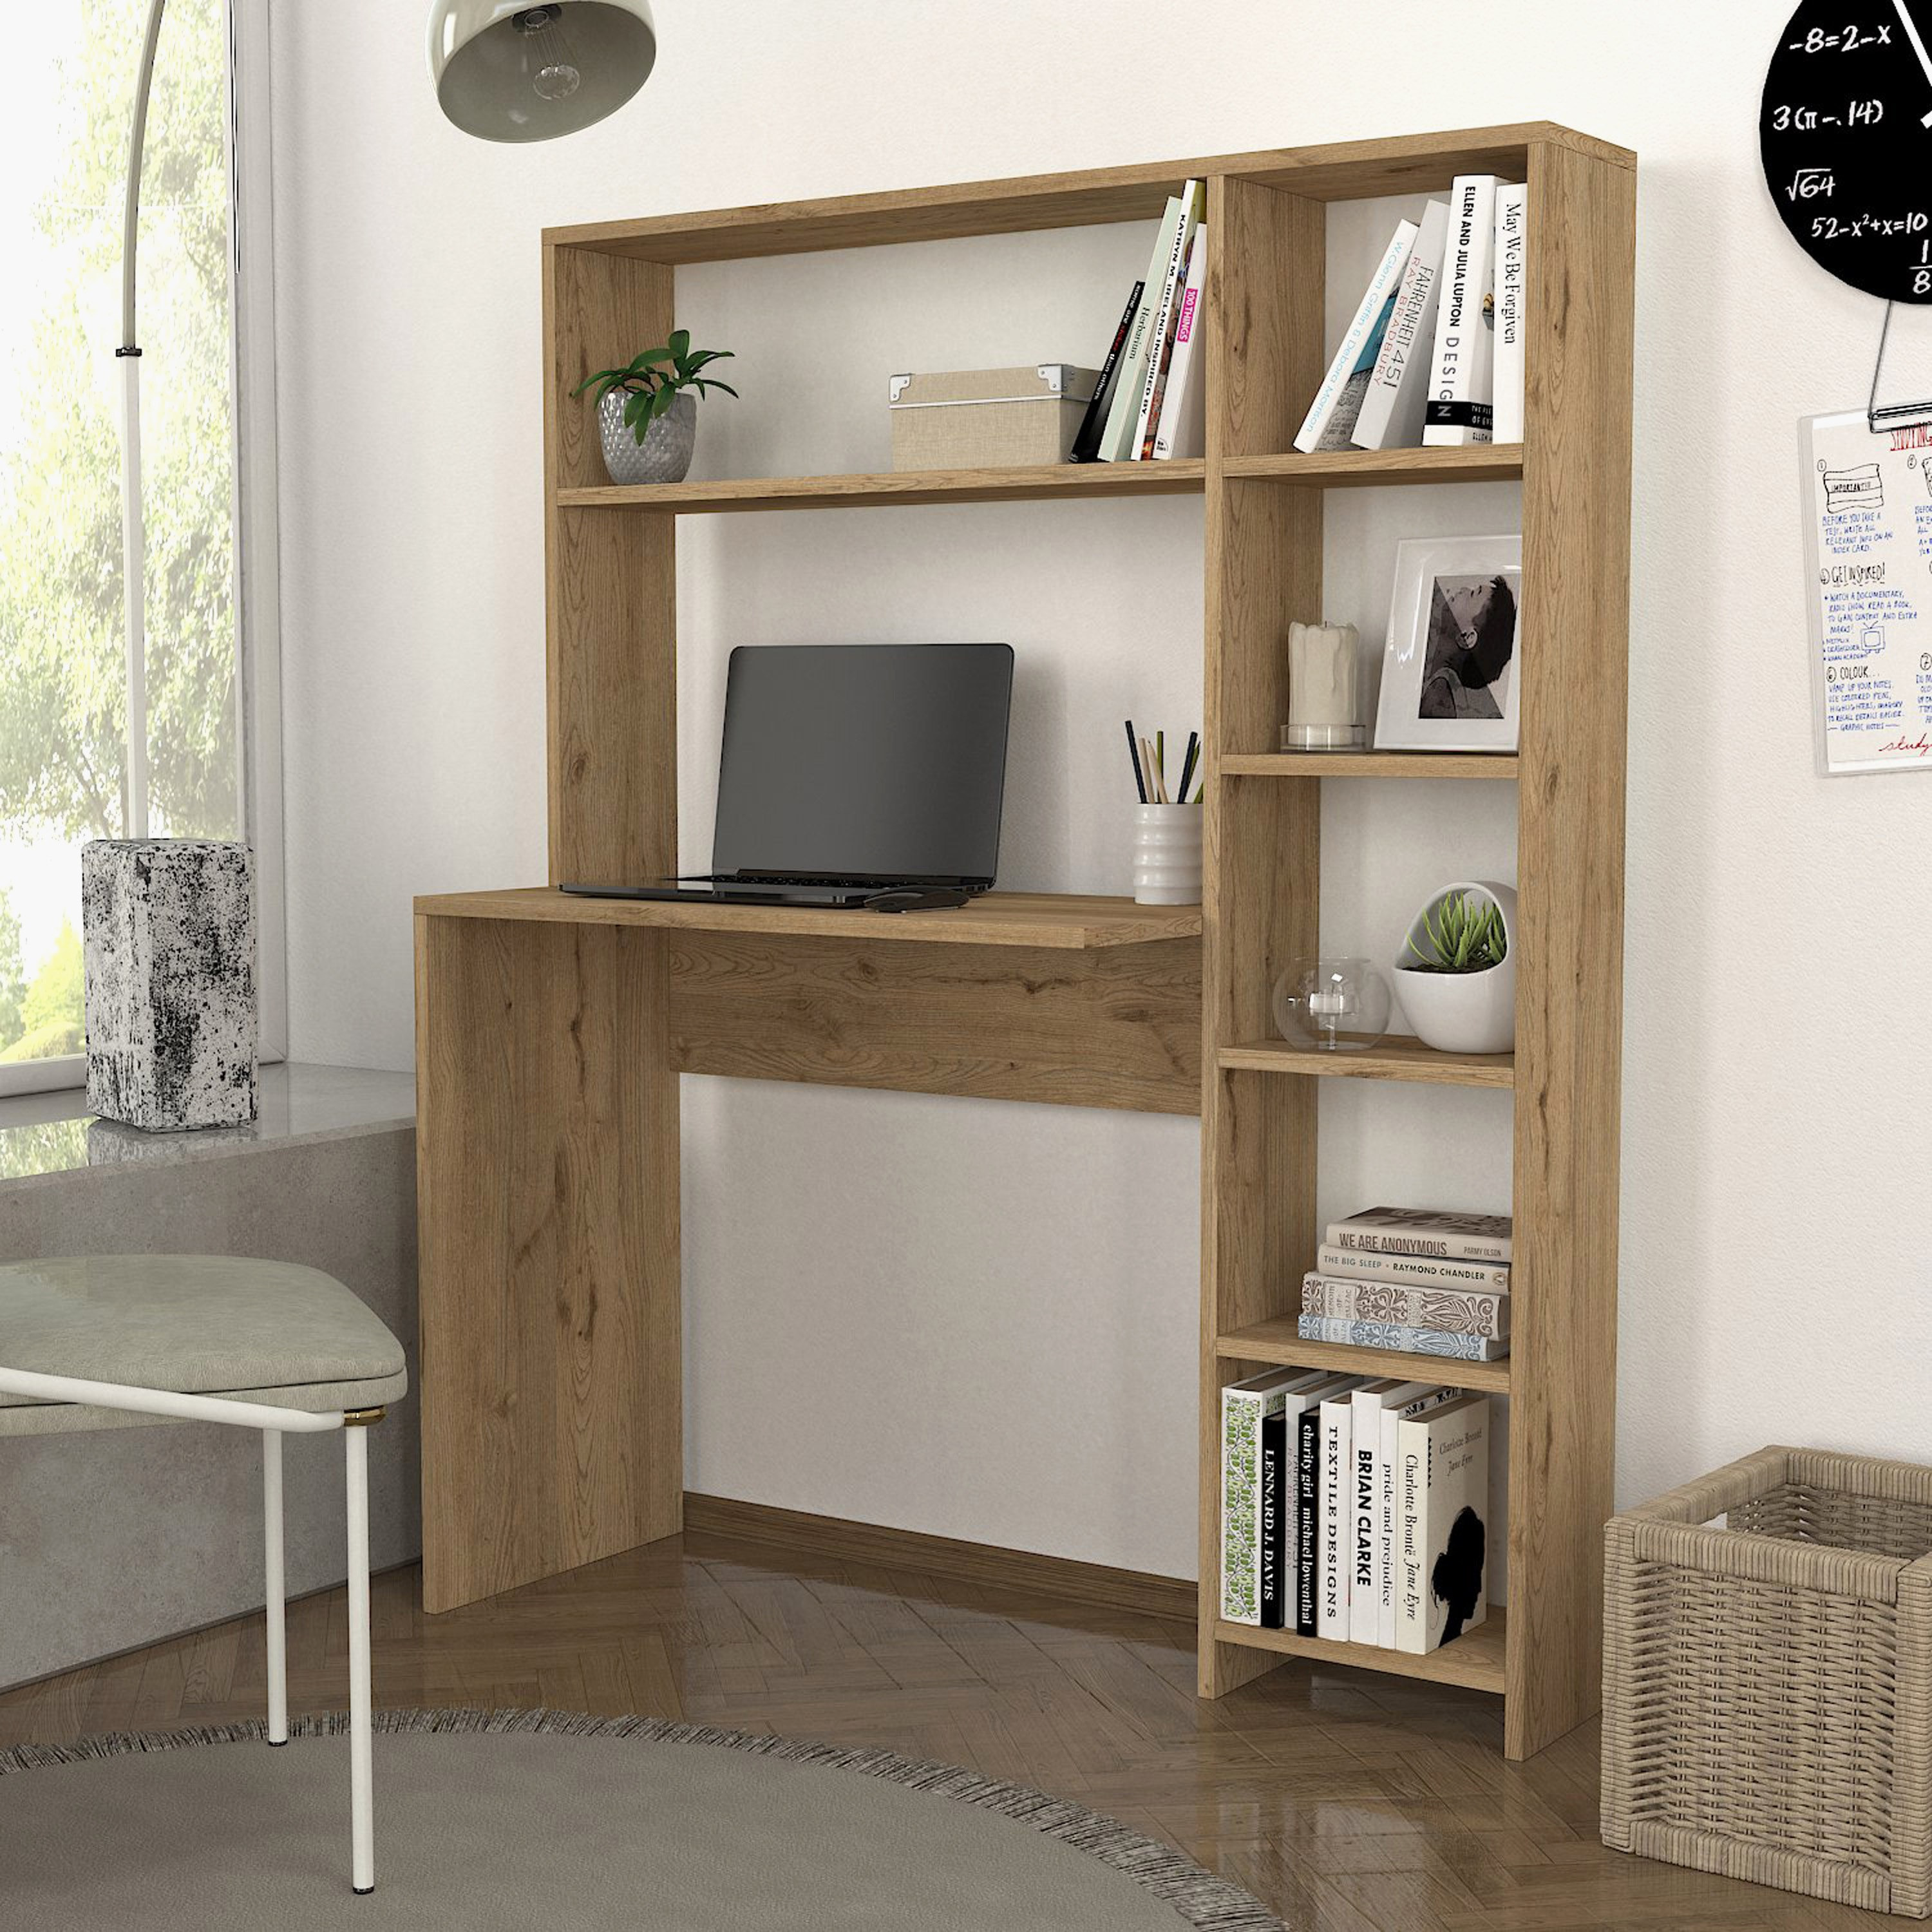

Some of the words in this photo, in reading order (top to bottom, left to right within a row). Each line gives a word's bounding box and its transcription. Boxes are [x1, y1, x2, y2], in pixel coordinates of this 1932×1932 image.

[1462, 185, 1476, 218] ELLEN
[1502, 202, 1522, 232] May
[1458, 220, 1472, 247] AND
[1505, 235, 1522, 260] We
[1406, 257, 1421, 289] RAY
[1454, 249, 1468, 281] JULIA
[1505, 263, 1521, 282] Be
[1157, 284, 1171, 336] IRELAND
[1186, 291, 1196, 305] 100
[1396, 265, 1434, 348] FAHRENHEIT
[1450, 283, 1465, 327] LUPTON
[1501, 284, 1522, 345] Forgiven
[1129, 307, 1150, 359] Herbarium
[1179, 307, 1194, 341] THINGS
[1374, 296, 1408, 386] BRADBURY
[1330, 339, 1357, 383] Debora
[1383, 350, 1405, 388] 451
[1437, 337, 1459, 417] DESIGN
[1324, 1255, 1339, 1264] THE
[1341, 1256, 1356, 1266] BIG
[1360, 1259, 1381, 1269] SLEEP
[1338, 1233, 1355, 1247] WE
[1358, 1234, 1378, 1249] ARE
[1381, 1236, 1448, 1255] ANONYMOUS
[1393, 1263, 1437, 1274] RAYMOND
[1439, 1267, 1485, 1280] CHANDLER
[1301, 1425, 1314, 1472] charity
[1264, 1449, 1274, 1528] LENNARD
[1300, 1474, 1313, 1497] girl
[1328, 1426, 1338, 1517] TEXTILE
[1358, 1450, 1372, 1511] BRIAN
[1383, 1464, 1394, 1502] pride
[1405, 1454, 1419, 1511] Charlotte
[1264, 1532, 1274, 1546] J.
[1302, 1508, 1312, 1558] michael
[1383, 1506, 1393, 1532] and
[1405, 1515, 1418, 1556] Brontë
[1357, 1513, 1372, 1586] CLARKE
[1264, 1550, 1274, 1601] DAVIS
[1327, 1524, 1337, 1618] DESIGNS
[1382, 1537, 1394, 1606] prejudice
[1404, 1558, 1420, 1590] Jane
[1302, 1560, 1312, 1624] lowenthal
[1404, 1593, 1420, 1620] Eyre
